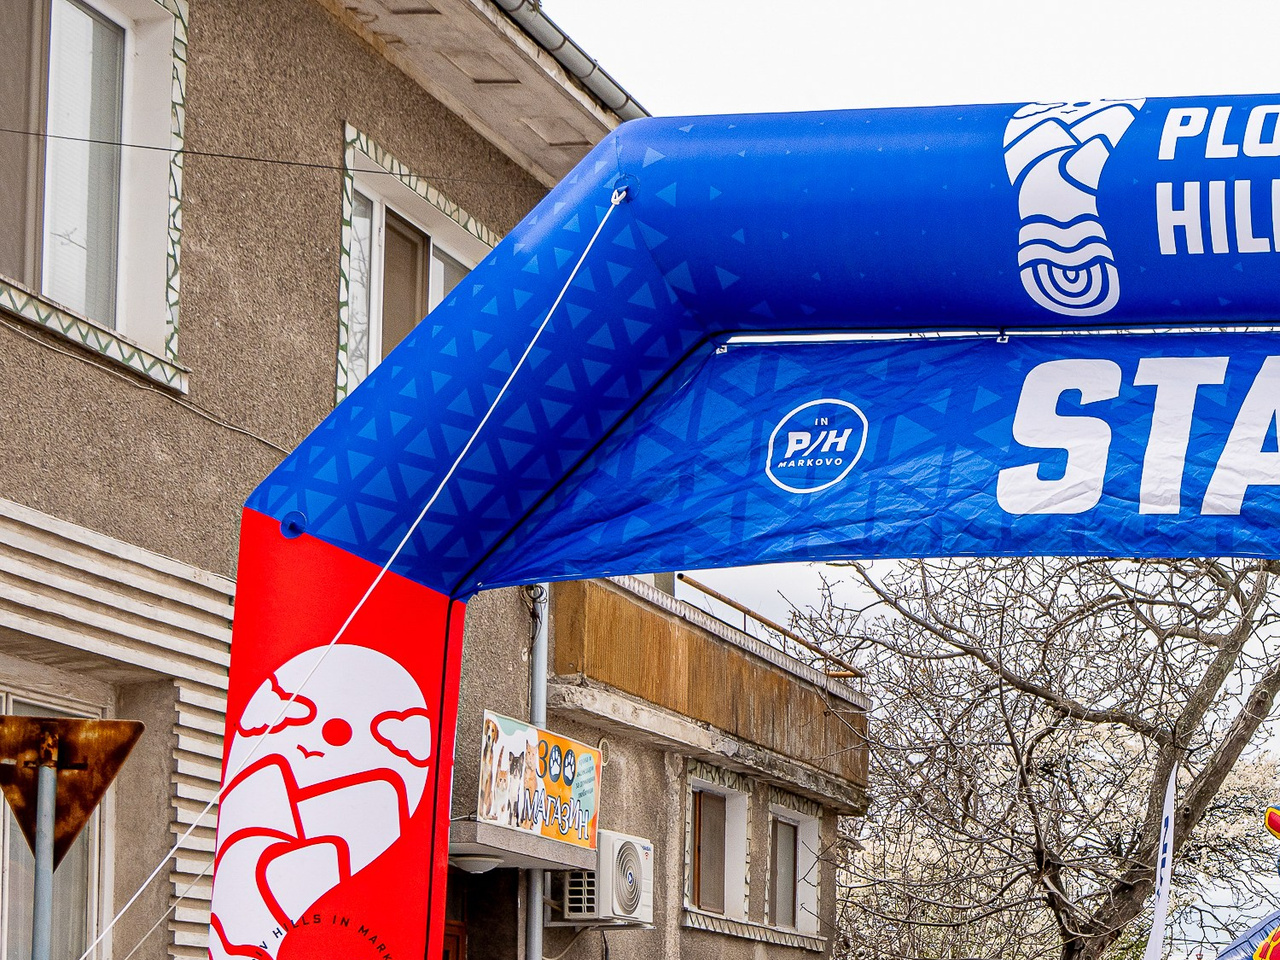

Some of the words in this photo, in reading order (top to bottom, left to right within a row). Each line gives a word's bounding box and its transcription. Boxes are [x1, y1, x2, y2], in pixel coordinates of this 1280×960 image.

[814, 417, 829, 426] IN
[784, 428, 853, 459] P/H
[777, 458, 843, 468] MARKOVO
[524, 788, 589, 840] МАГАЗИН
[272, 914, 321, 938] HILLS
[333, 915, 350, 927] IN
